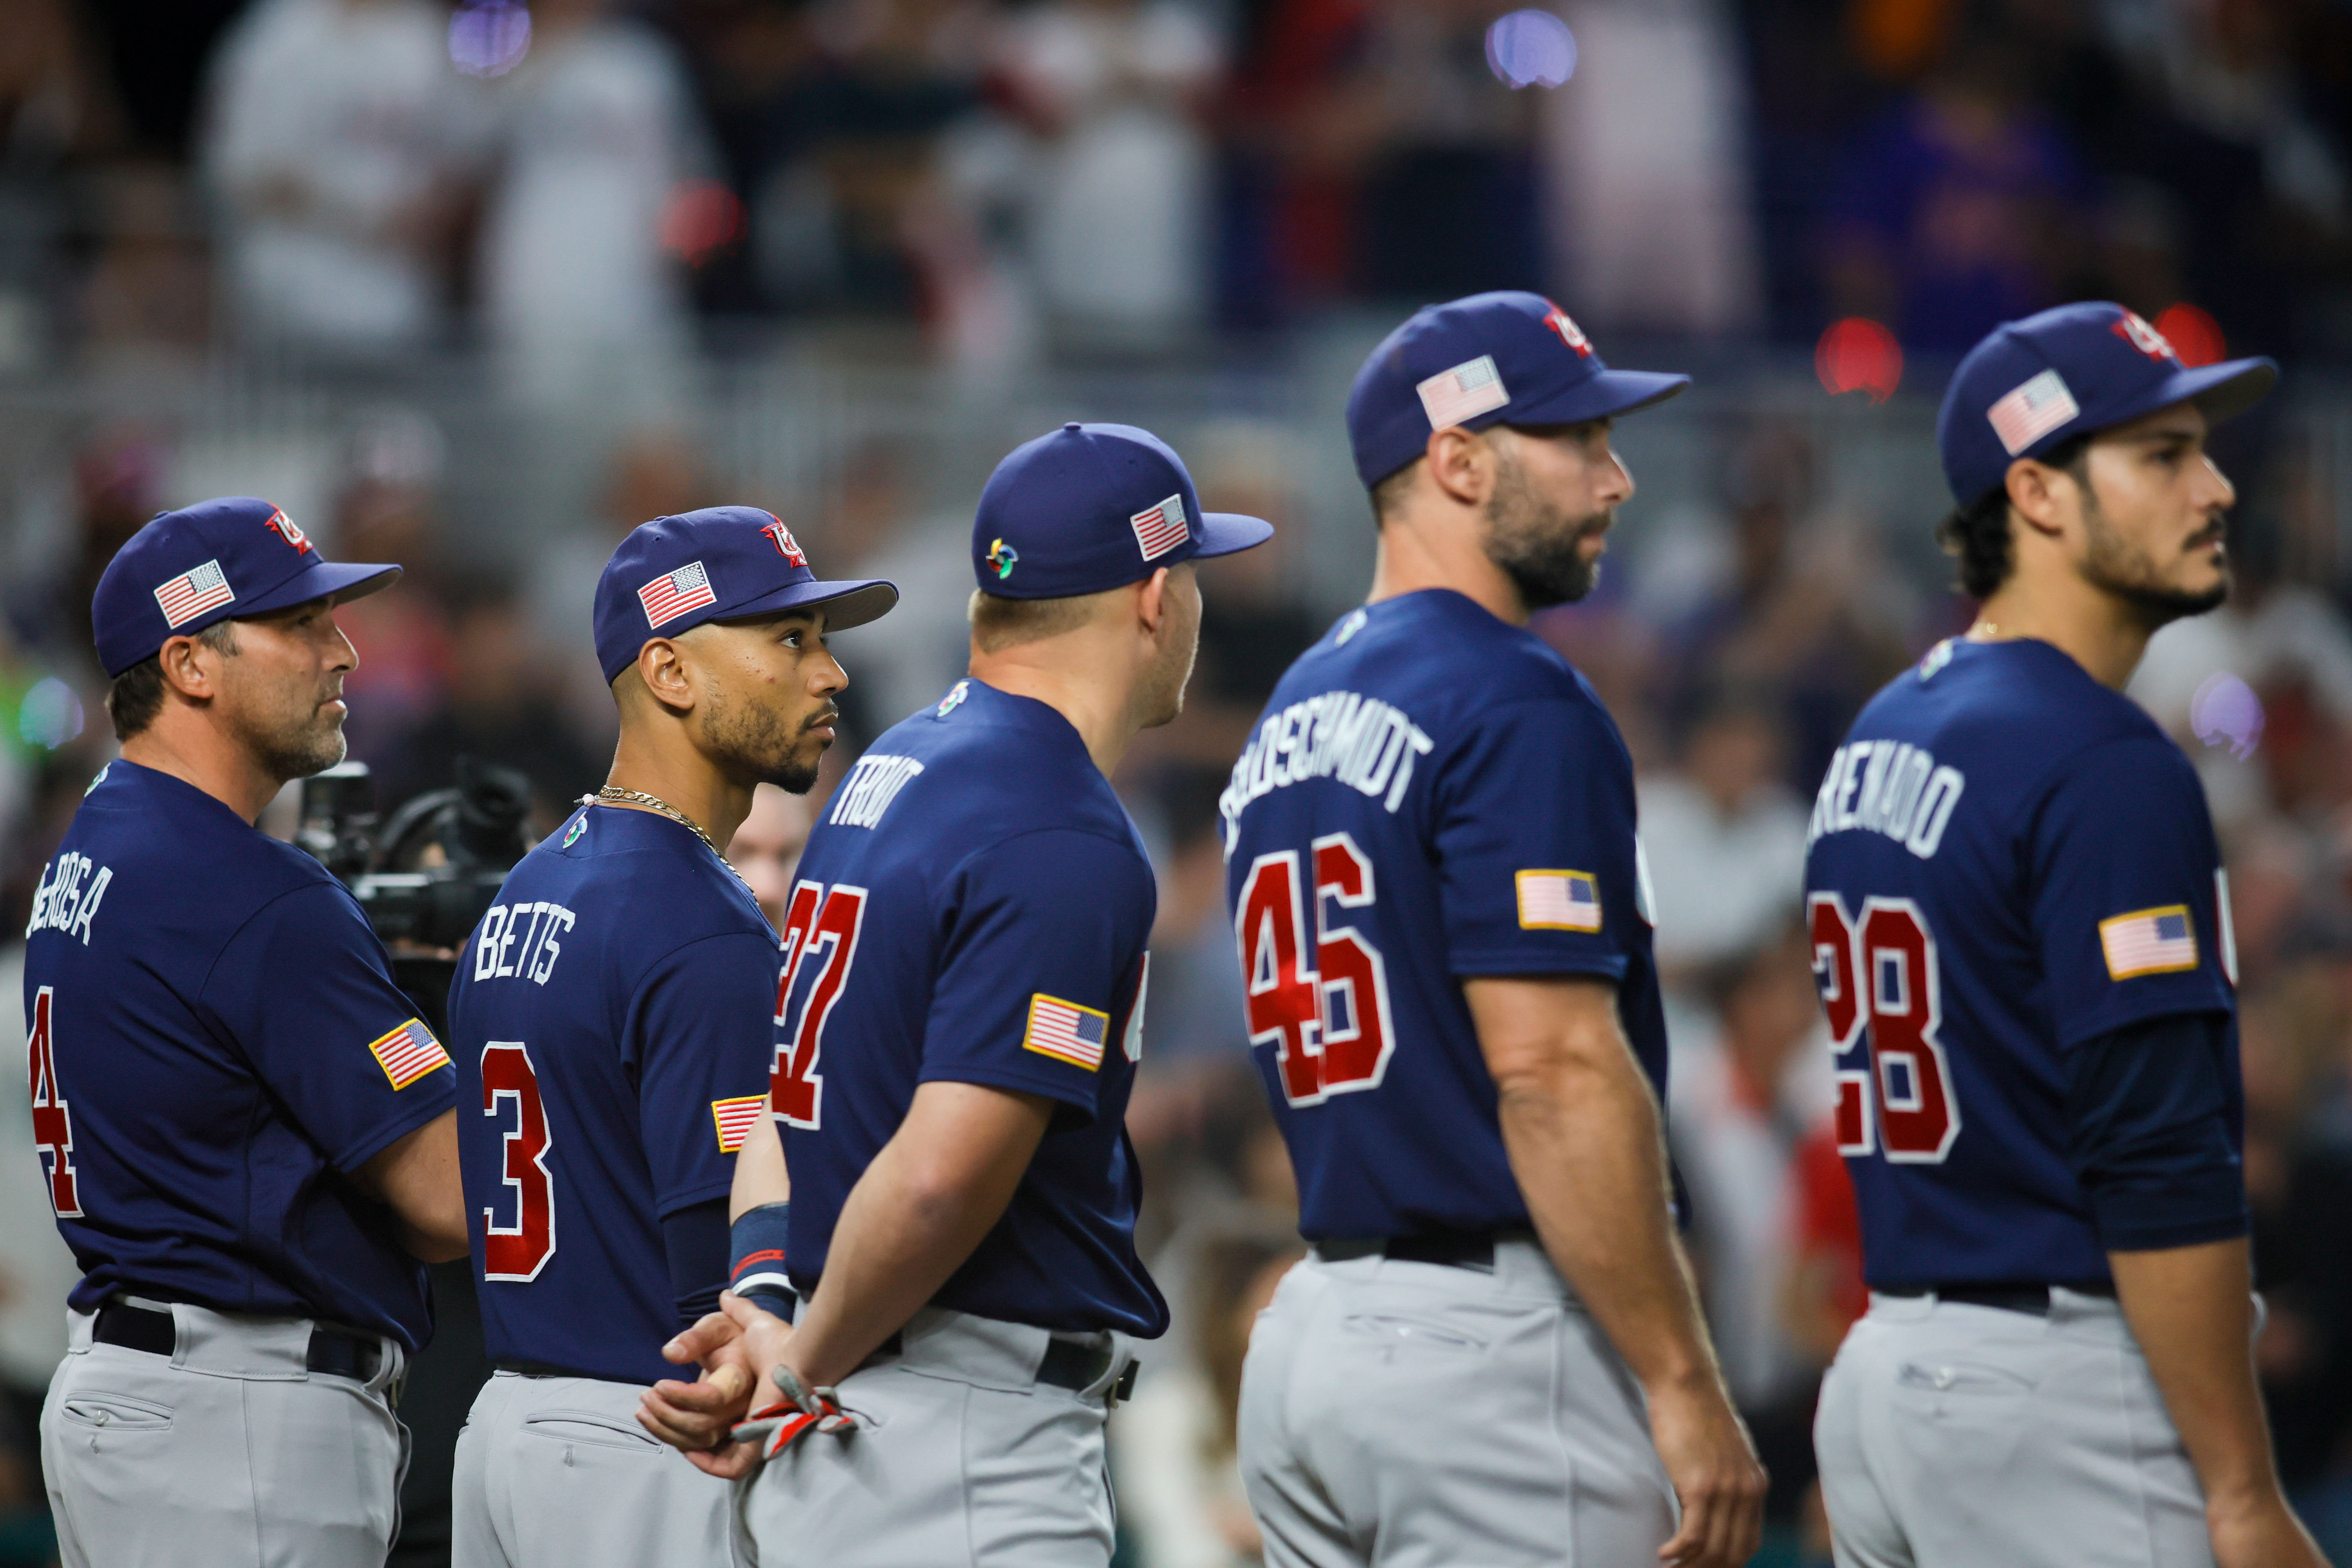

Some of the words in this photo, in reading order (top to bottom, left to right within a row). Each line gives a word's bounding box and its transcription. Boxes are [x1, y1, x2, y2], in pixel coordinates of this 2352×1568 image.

[829, 754, 925, 830] TROUT
[1806, 738, 1965, 860] RENADO
[474, 901, 576, 987] BETTS
[27, 985, 85, 1218] 4
[480, 1040, 556, 1283] 3
